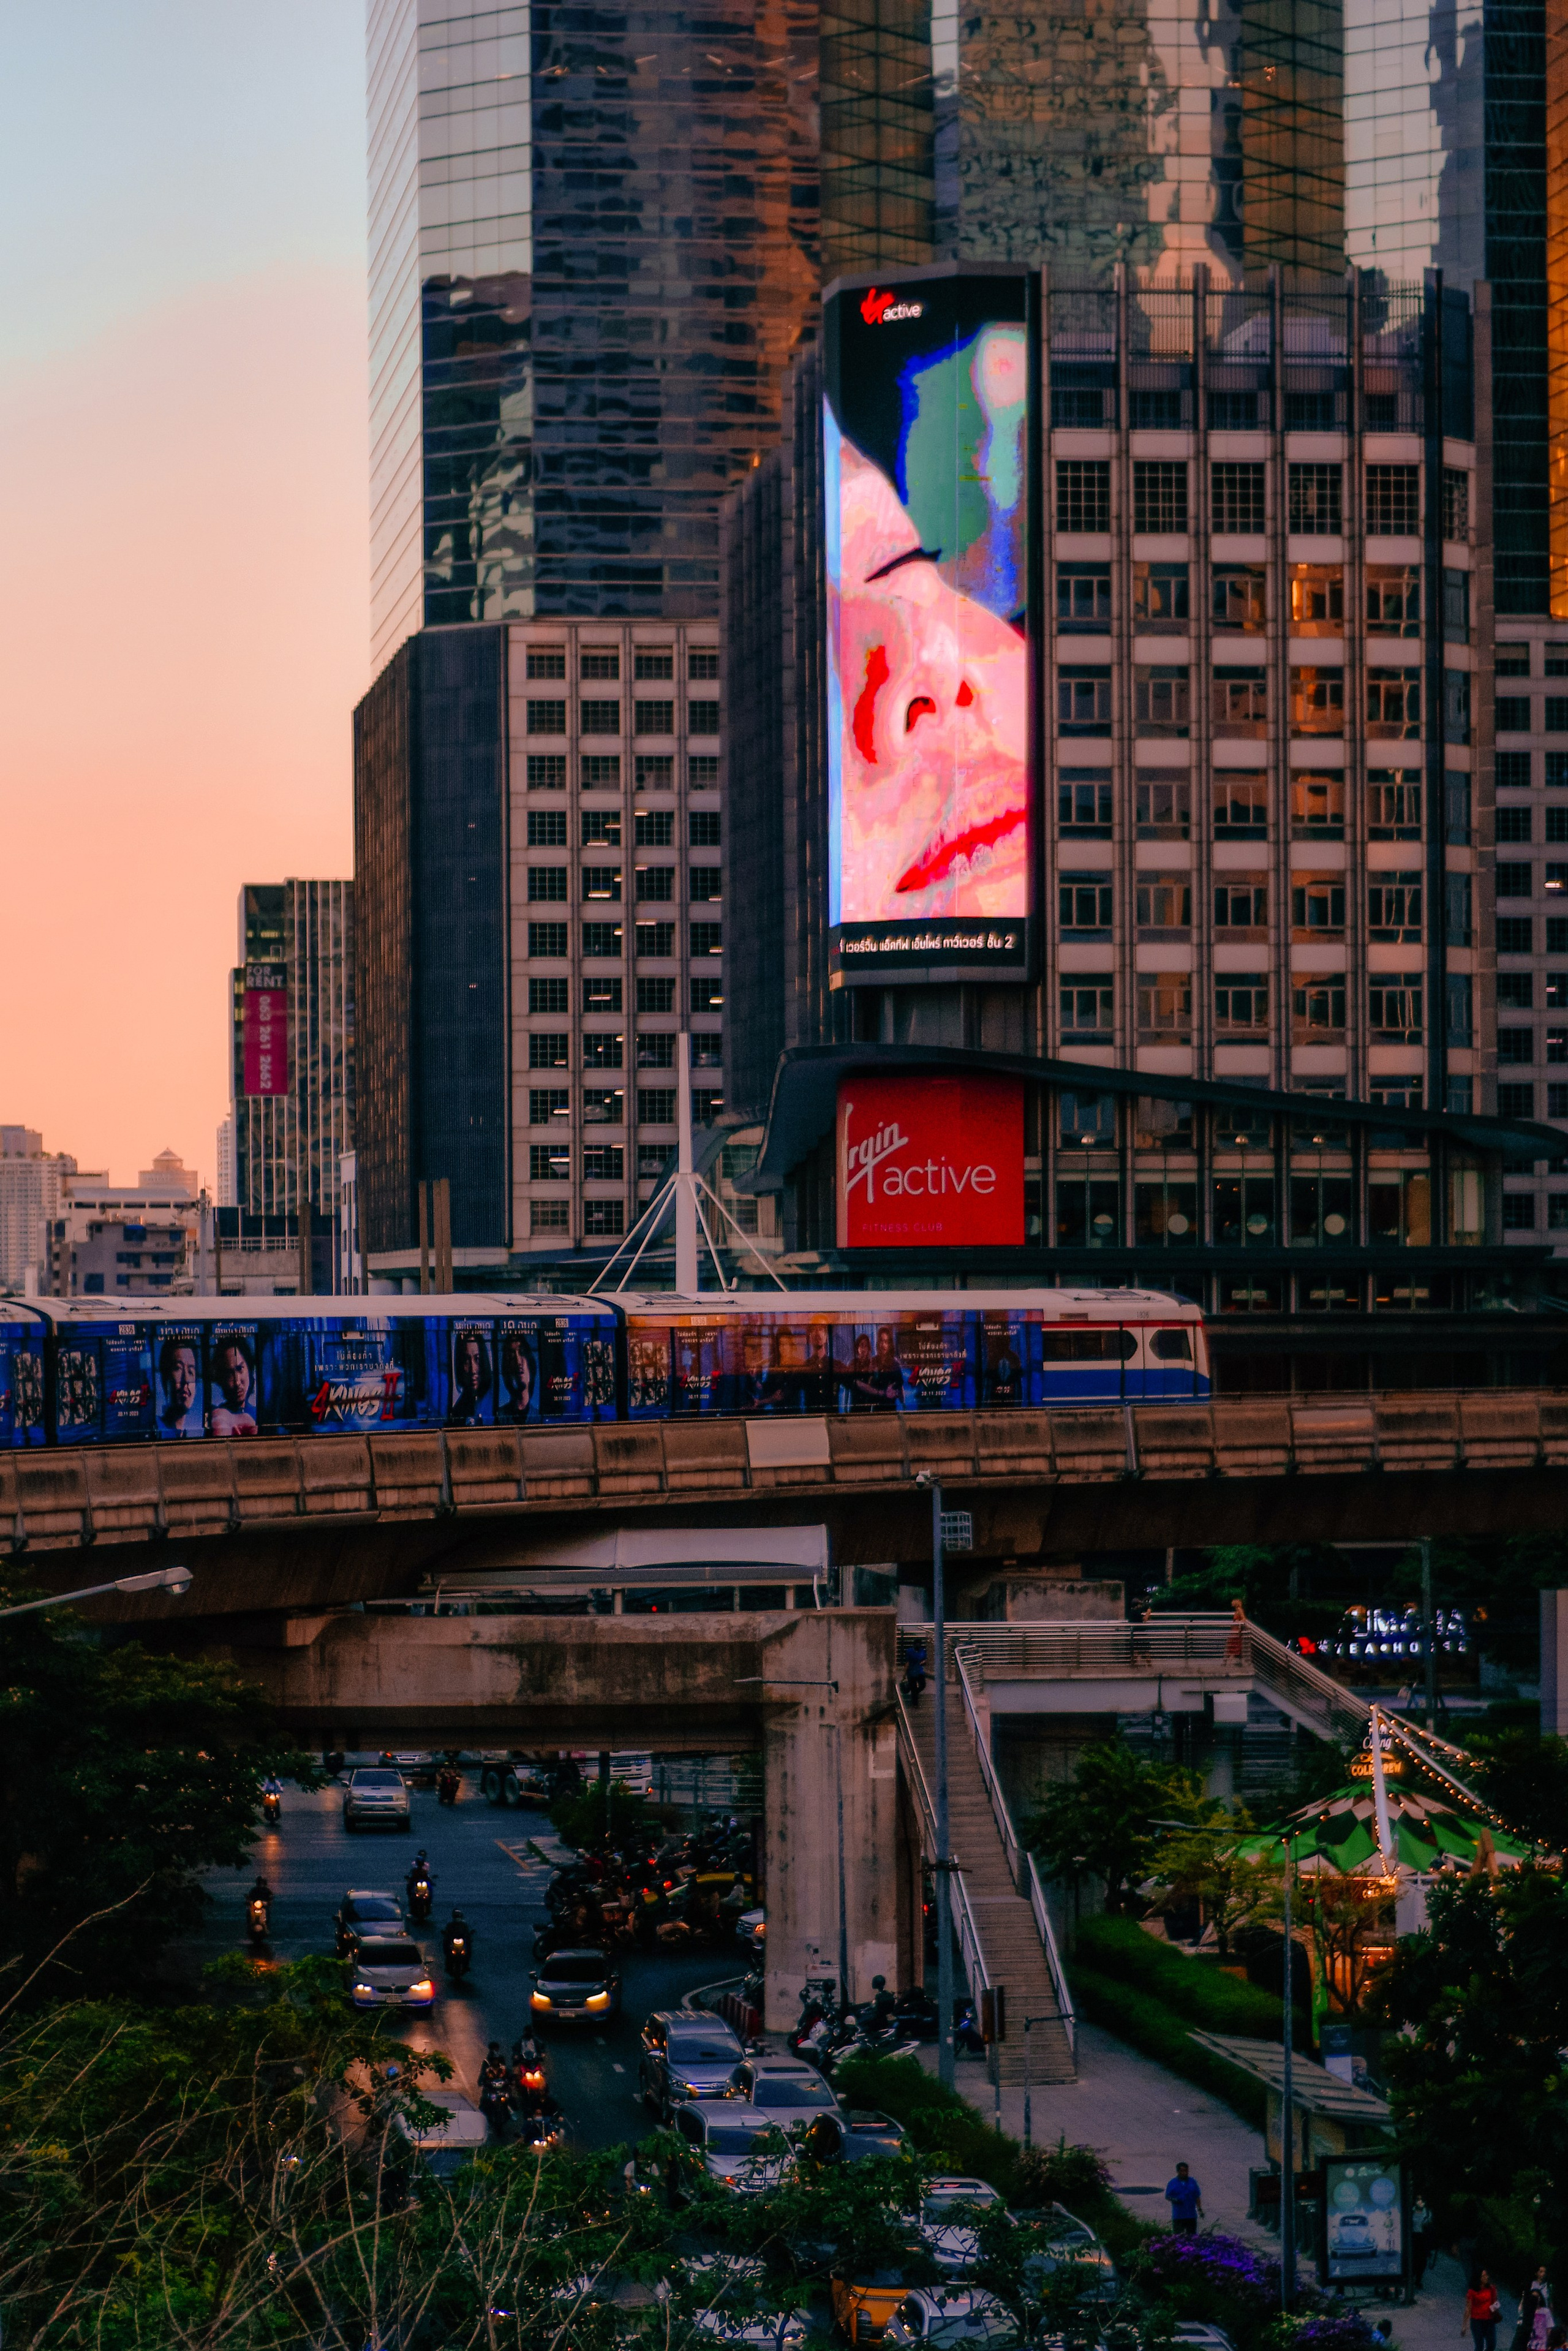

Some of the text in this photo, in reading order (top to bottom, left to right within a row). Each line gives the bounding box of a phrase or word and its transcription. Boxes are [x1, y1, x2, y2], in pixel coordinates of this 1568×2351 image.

[883, 303, 922, 322] active
[1005, 935, 1015, 949] 2
[246, 966, 271, 975] FOR
[246, 975, 283, 987] RENT
[883, 1157, 997, 1195] active
[862, 1223, 943, 1232] FITNESS CLUB
[120, 1326, 134, 1334] 2836
